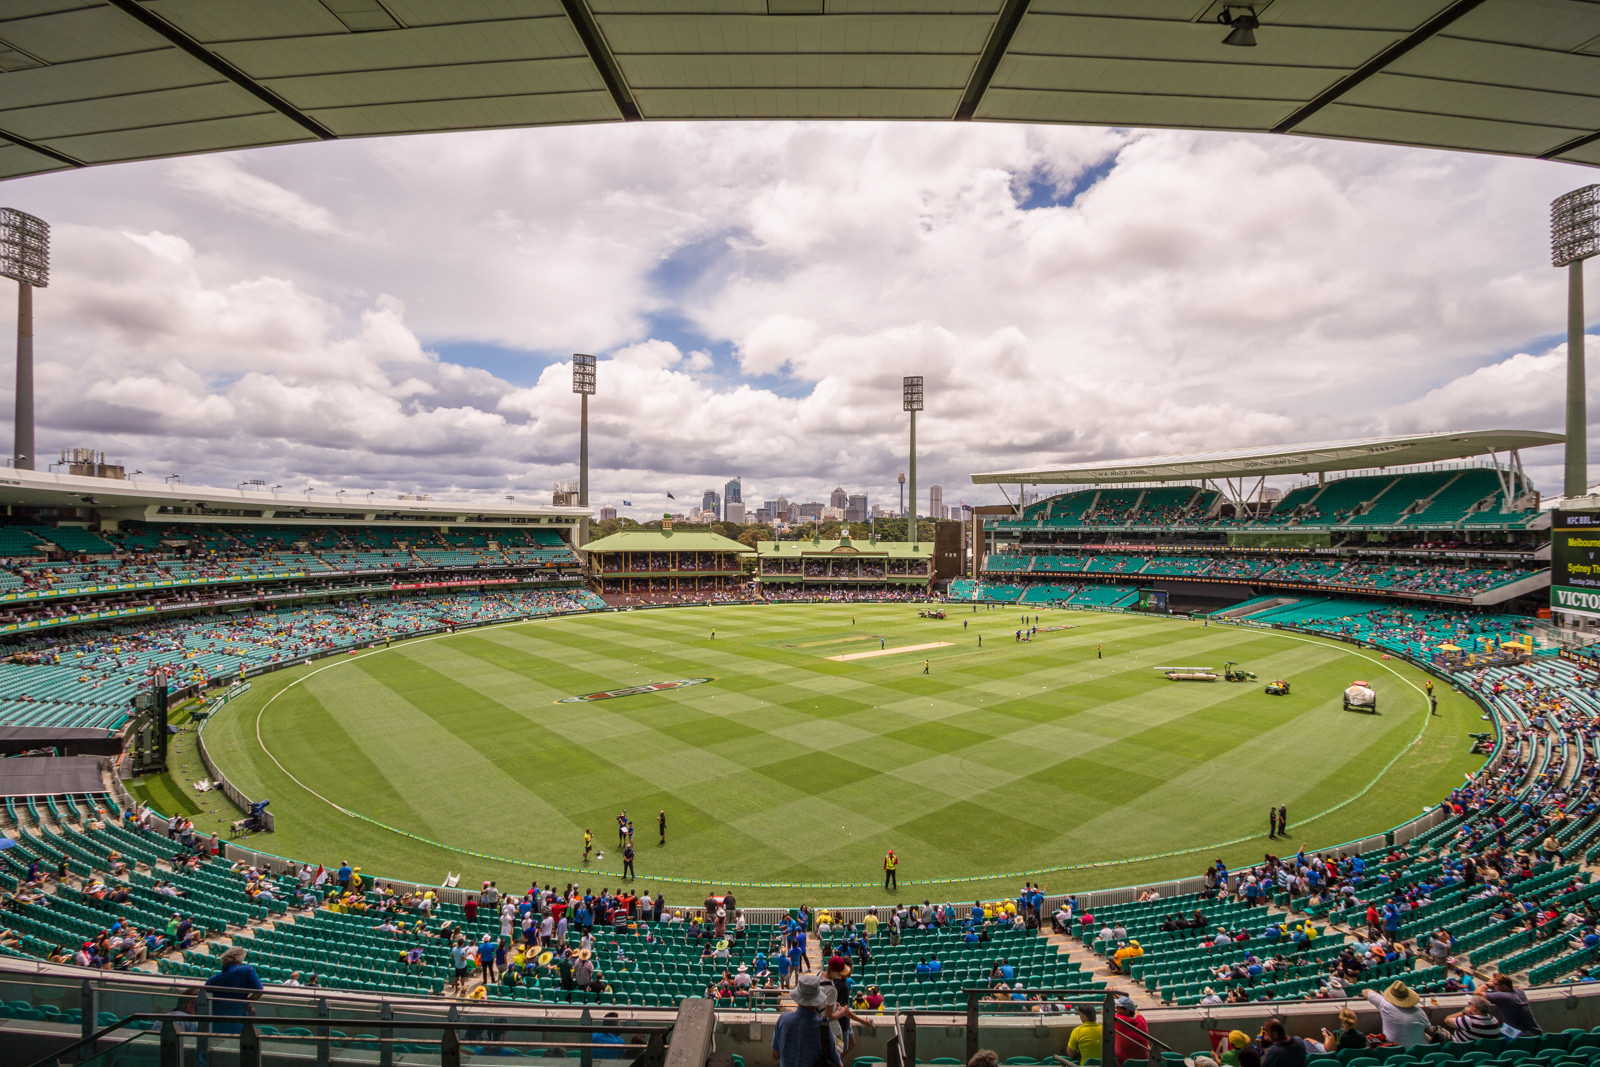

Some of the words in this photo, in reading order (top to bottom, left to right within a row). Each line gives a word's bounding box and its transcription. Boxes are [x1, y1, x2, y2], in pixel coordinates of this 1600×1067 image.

[1259, 459, 1286, 467] BADMAN
[1567, 516, 1578, 524] KFC
[1579, 516, 1591, 524] BBL
[1568, 563, 1591, 575] Sydney
